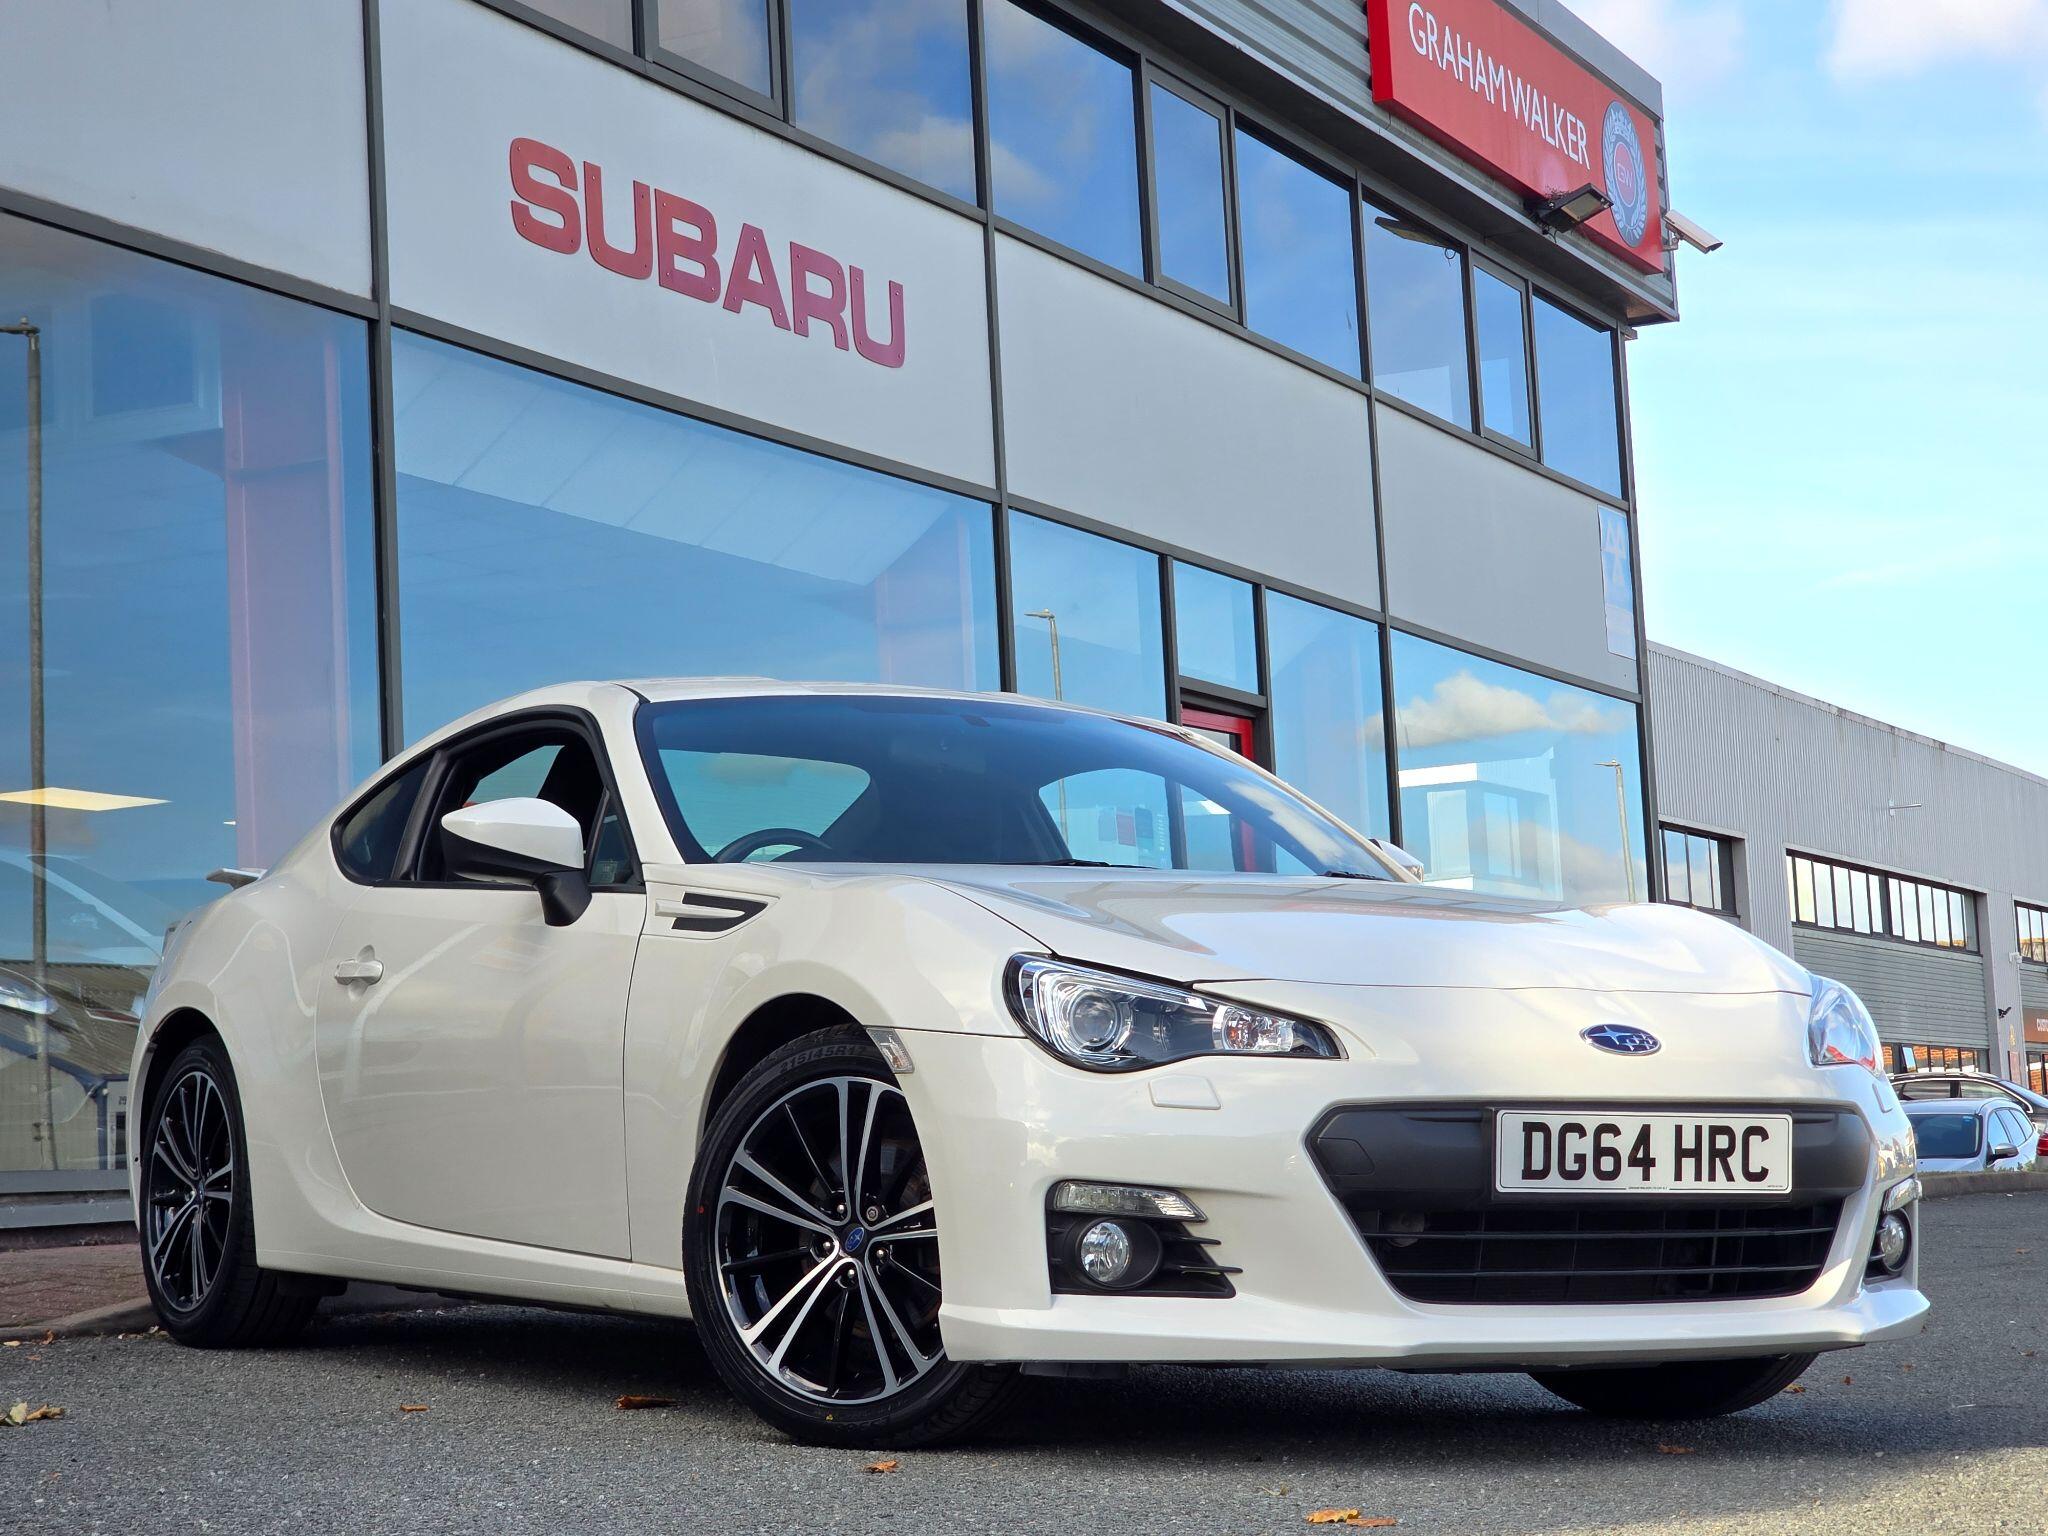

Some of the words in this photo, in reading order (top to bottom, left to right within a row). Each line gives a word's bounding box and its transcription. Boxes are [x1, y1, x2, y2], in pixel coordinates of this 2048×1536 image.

[1408, 2, 1507, 113] GRAHAM
[1507, 69, 1591, 171] WALKER
[509, 136, 906, 369] SUBARU
[1521, 1121, 1656, 1182] DG64
[1674, 1124, 1770, 1183] HRC
